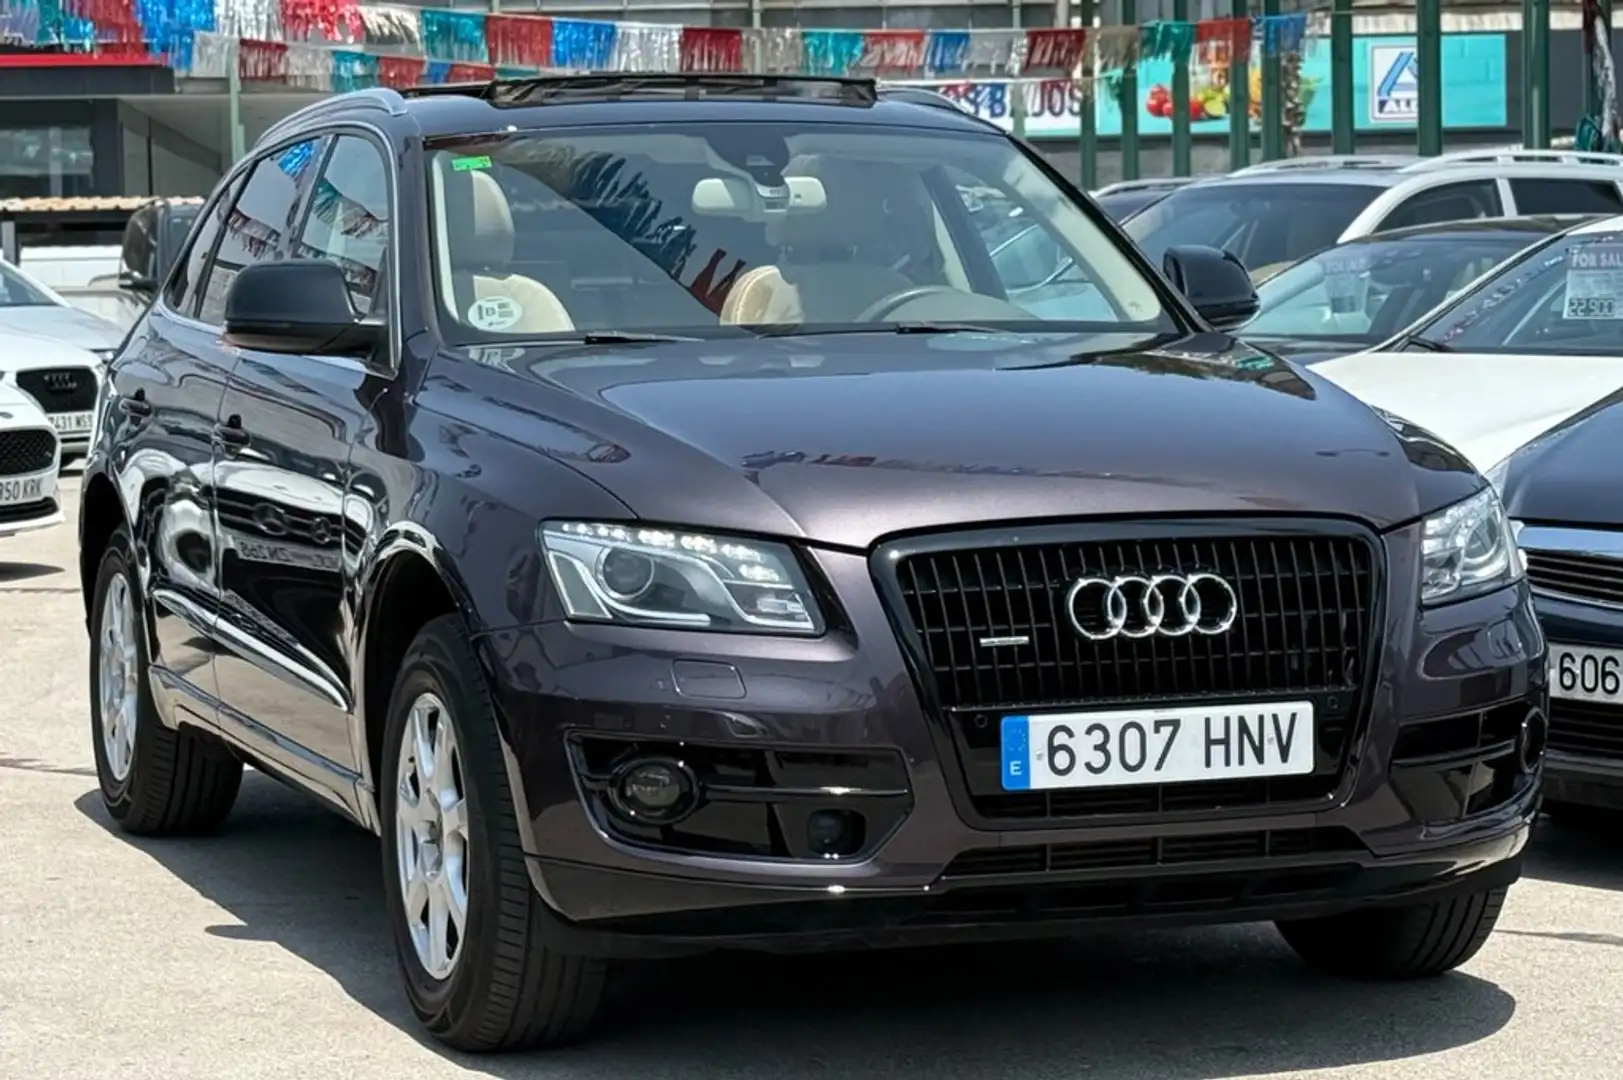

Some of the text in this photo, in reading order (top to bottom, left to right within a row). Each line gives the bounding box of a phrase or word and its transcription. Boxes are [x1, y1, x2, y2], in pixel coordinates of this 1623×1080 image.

[1559, 651, 1620, 696] 606
[1047, 712, 1298, 777] 6307 HNV
[1010, 760, 1022, 776] E
